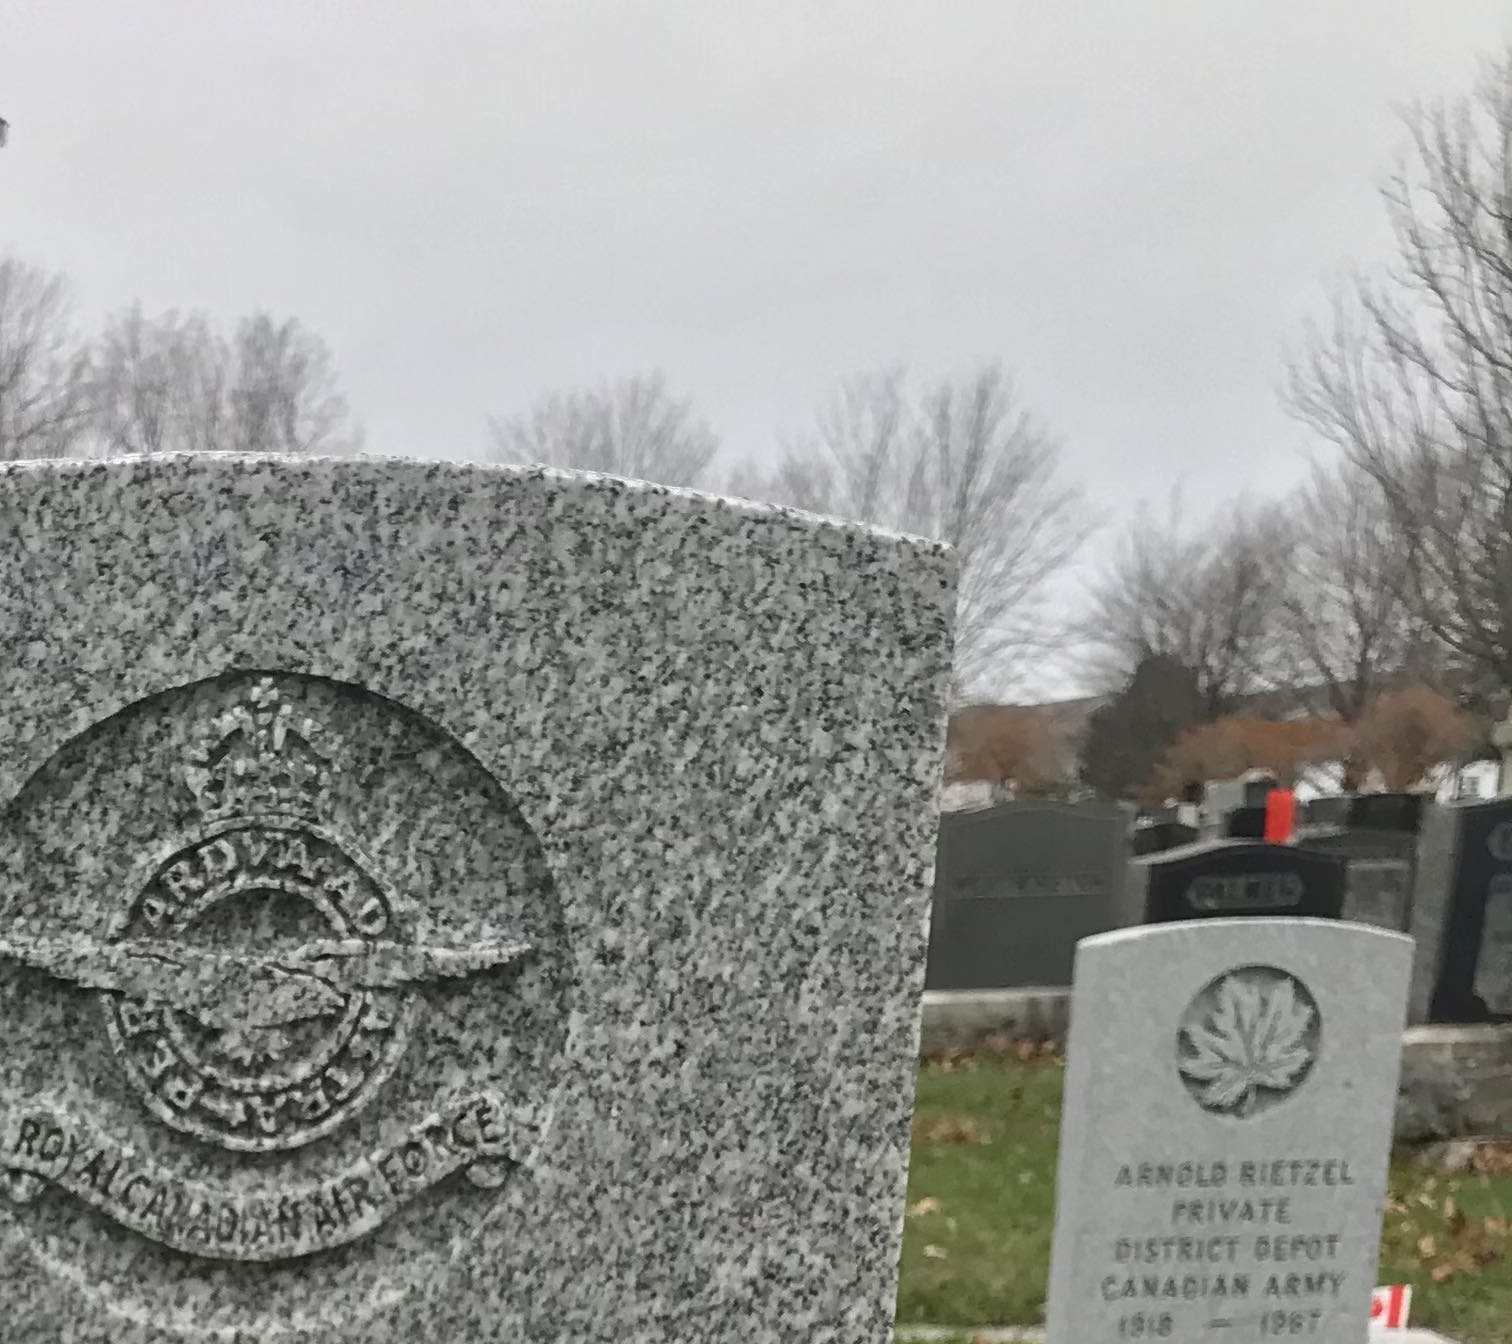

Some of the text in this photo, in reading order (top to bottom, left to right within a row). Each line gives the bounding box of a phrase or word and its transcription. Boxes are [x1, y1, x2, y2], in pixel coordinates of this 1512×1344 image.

[14, 1115, 122, 1197] ROYAL
[118, 1174, 302, 1246] CANADIAN
[376, 1098, 502, 1196] FORCE
[1113, 1161, 1228, 1188] ARNOLD
[1172, 1198, 1292, 1225] PRIVATE
[1115, 1233, 1340, 1264] DISTRICT DEPOT
[1100, 1271, 1347, 1301] CANADIAN ARMY
